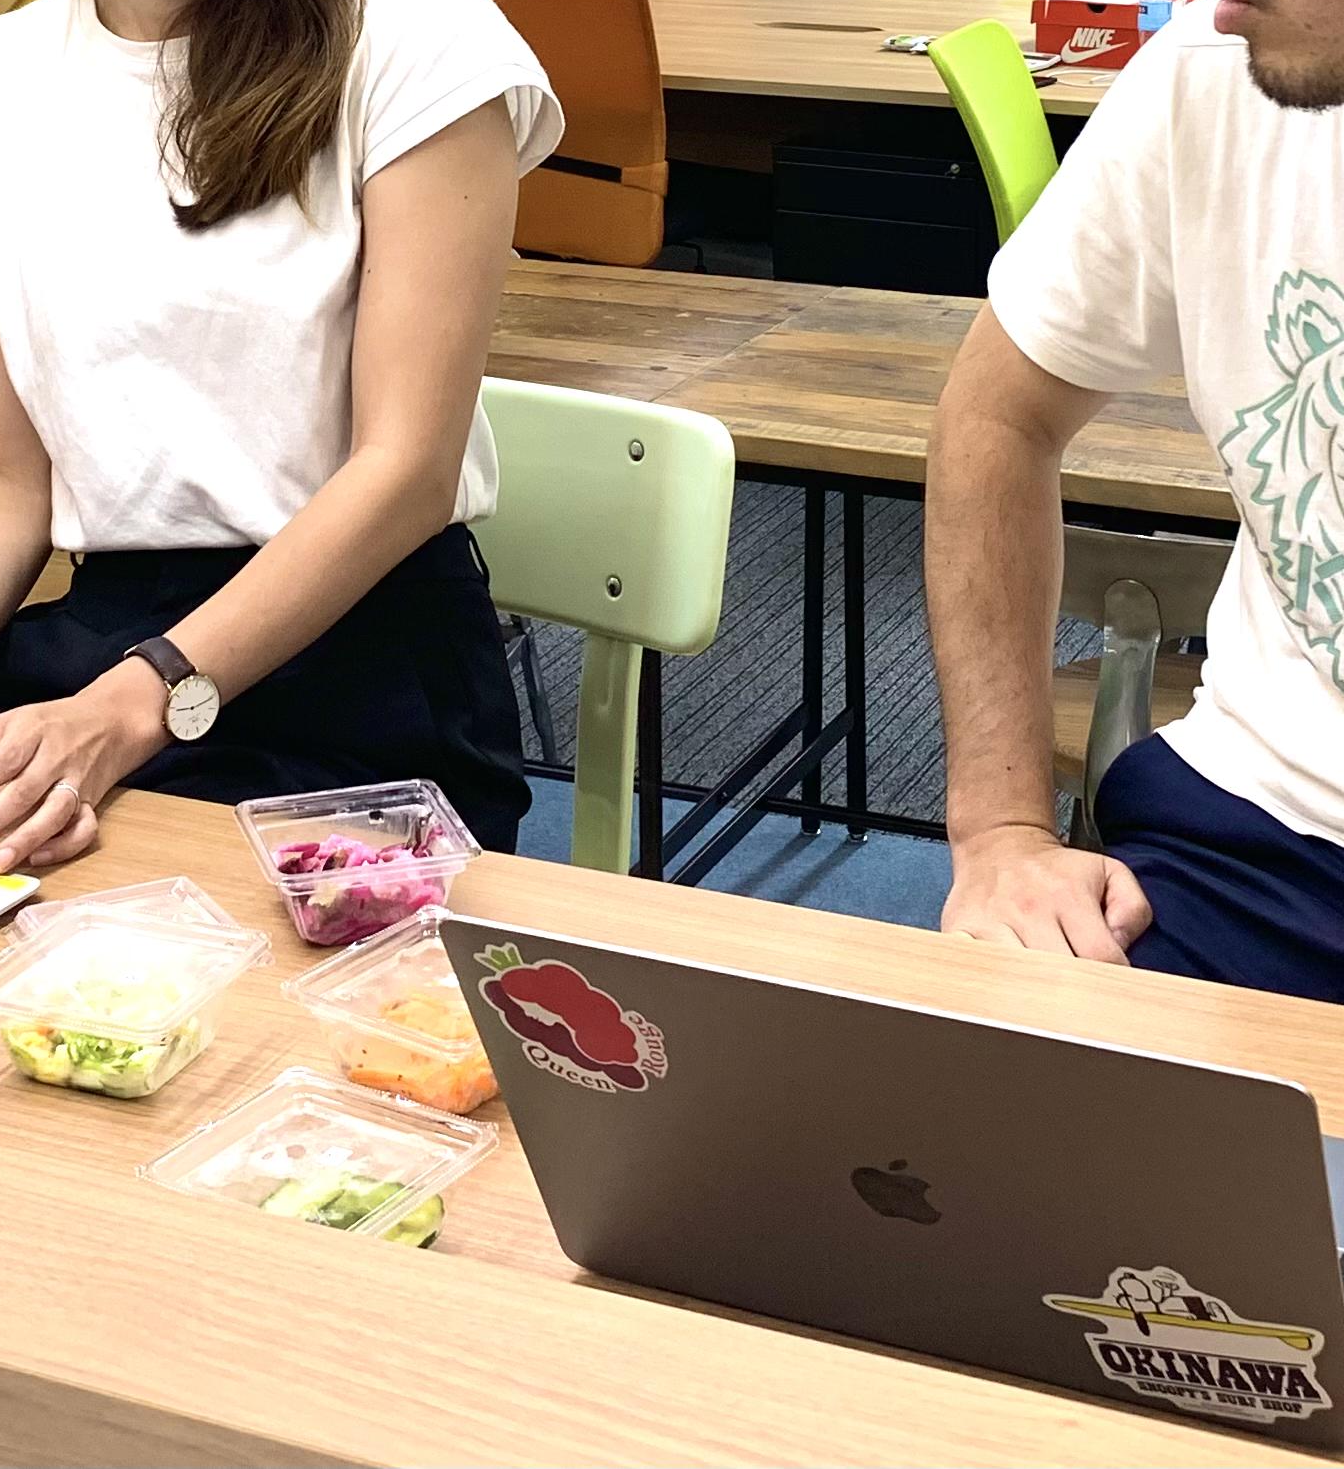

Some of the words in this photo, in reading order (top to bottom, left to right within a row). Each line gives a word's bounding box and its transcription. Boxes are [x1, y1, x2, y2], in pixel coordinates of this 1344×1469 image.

[1070, 27, 1116, 49] NIKE
[527, 1045, 614, 1090] Queen
[628, 1015, 666, 1076] Rouge
[1098, 1342, 1321, 1400] OKINAWA
